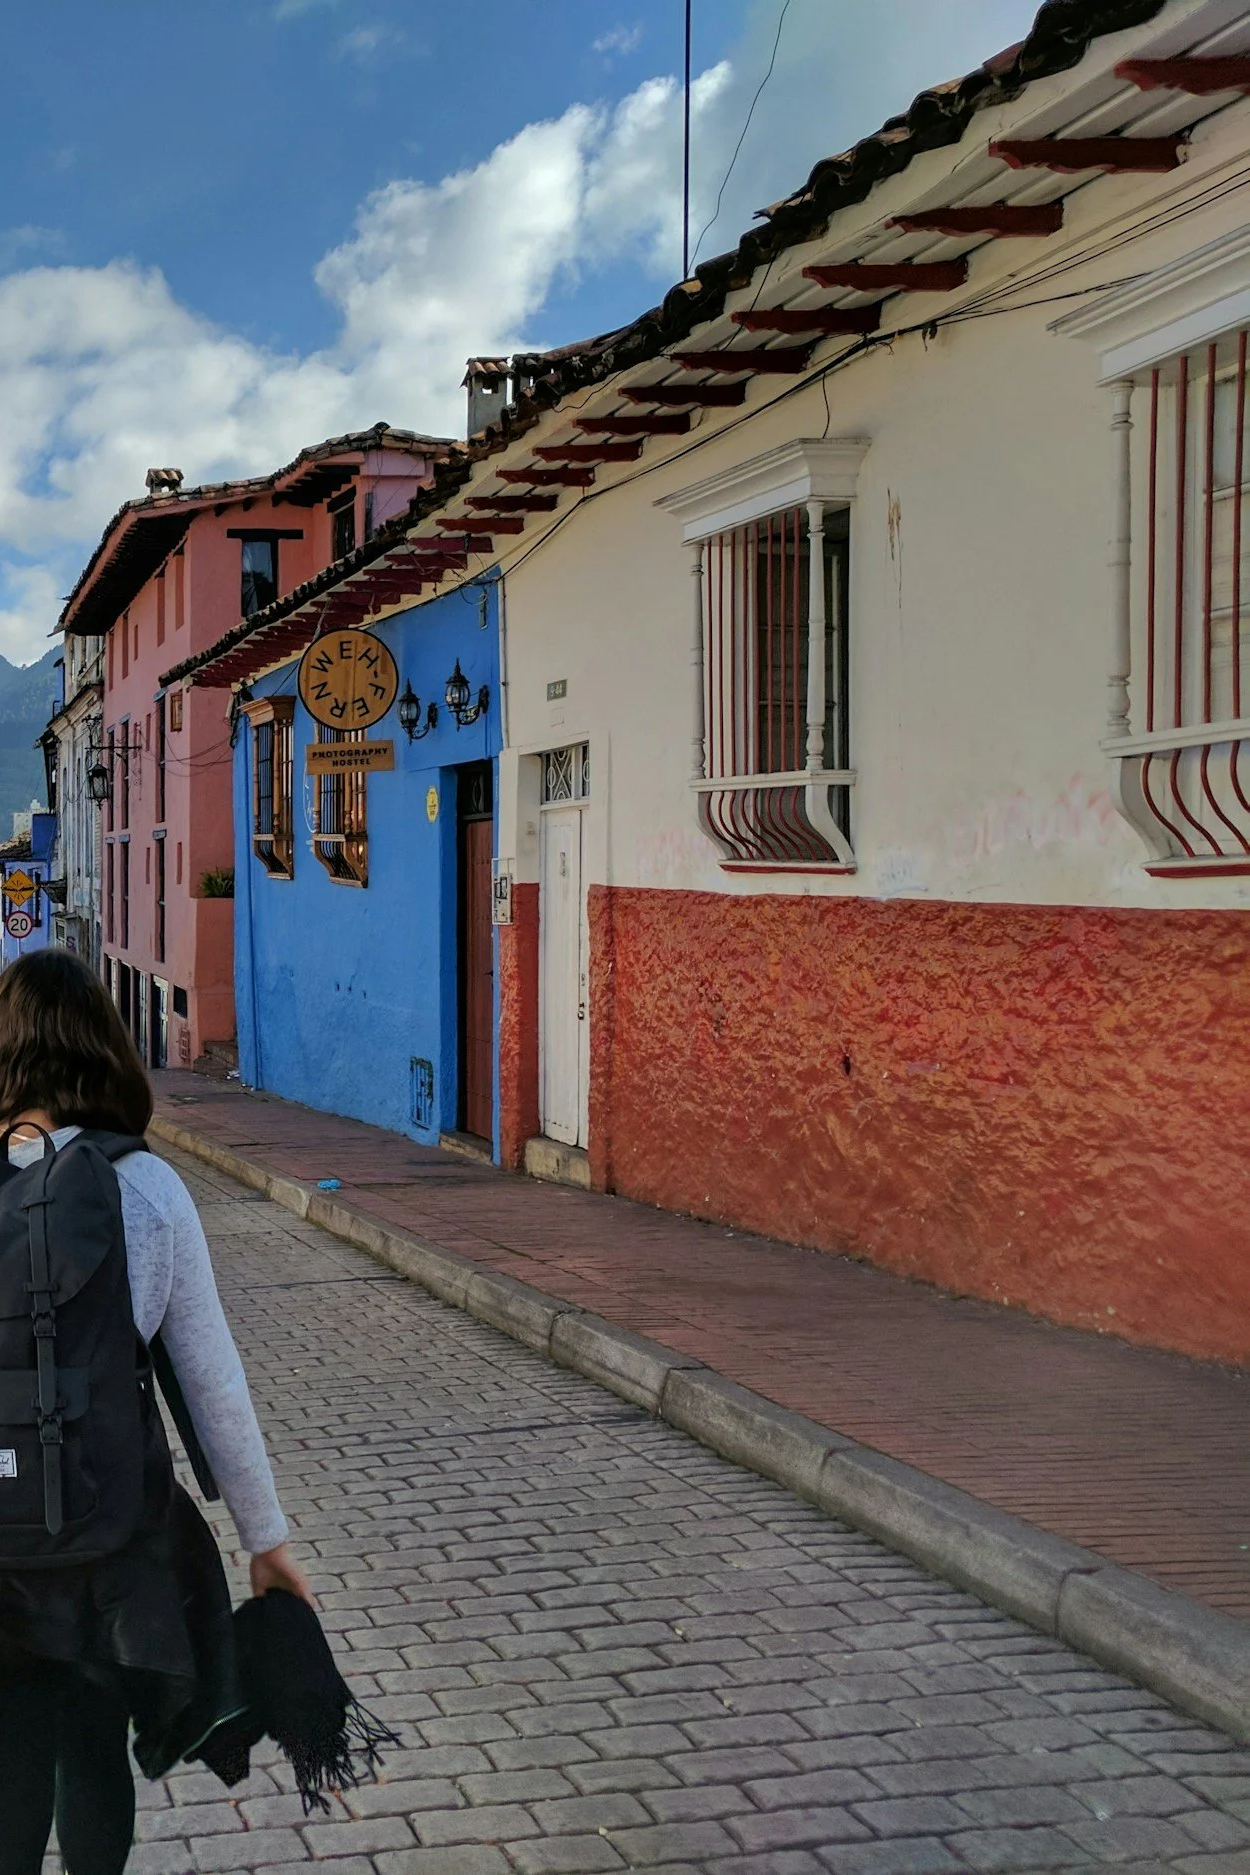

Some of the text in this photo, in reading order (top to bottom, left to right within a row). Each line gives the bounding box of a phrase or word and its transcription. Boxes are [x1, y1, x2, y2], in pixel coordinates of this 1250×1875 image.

[312, 747, 388, 759] PHOTOGRAPHY
[332, 758, 371, 767] HOSTEL
[10, 918, 28, 931] 20
